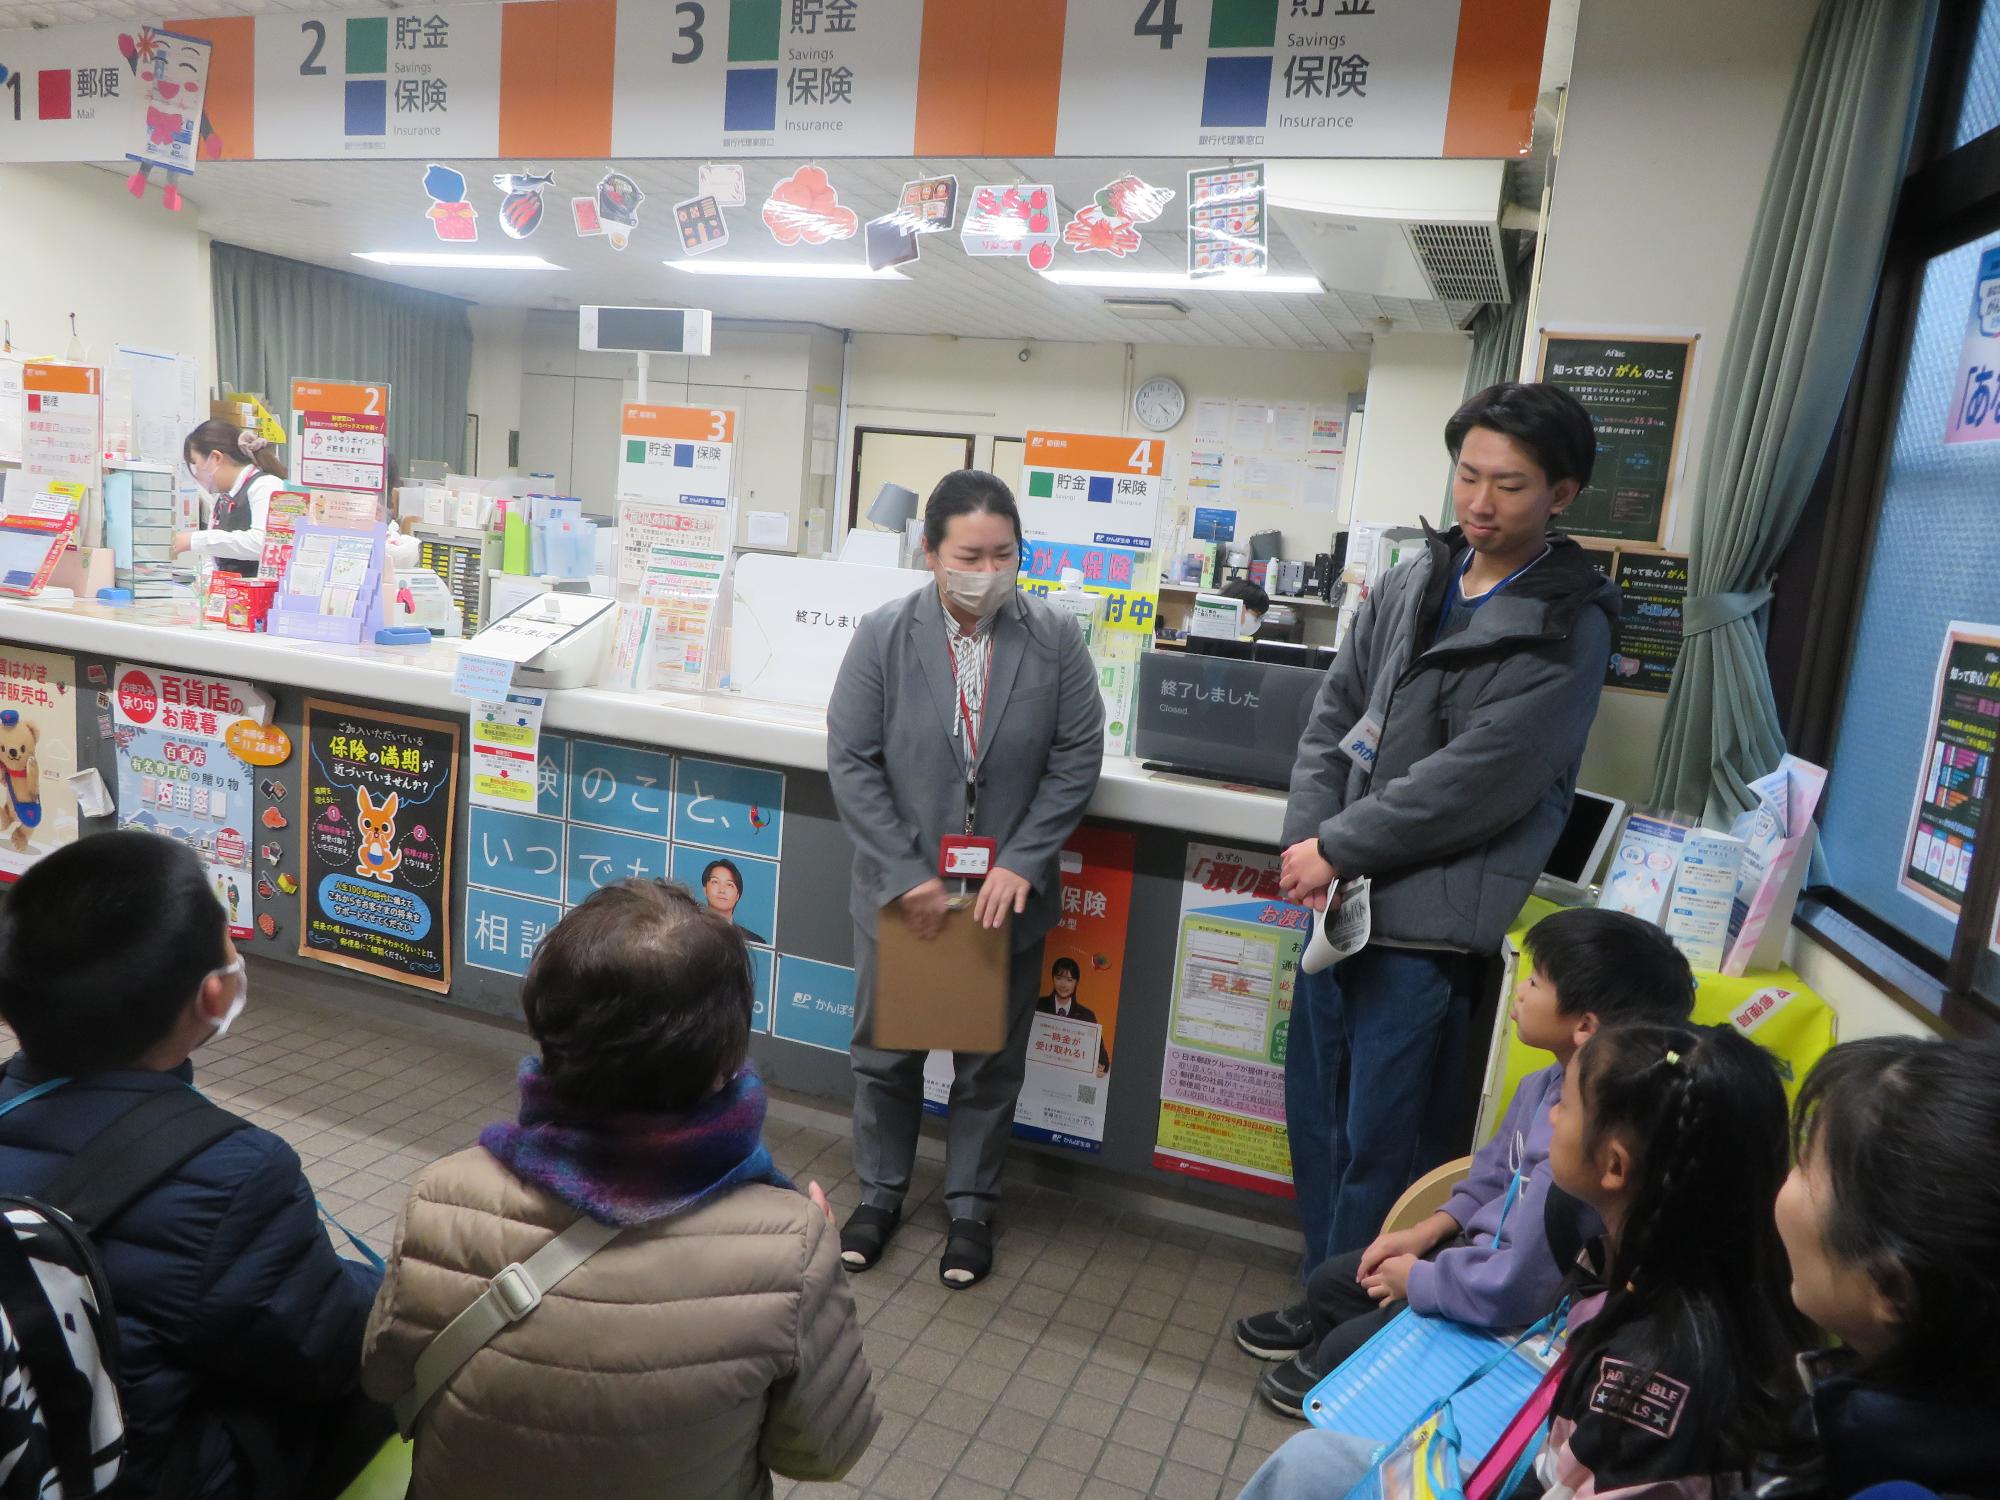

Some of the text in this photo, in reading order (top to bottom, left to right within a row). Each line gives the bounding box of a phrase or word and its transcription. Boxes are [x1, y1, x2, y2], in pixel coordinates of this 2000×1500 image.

[790, 0, 858, 34] 貯金
[1134, 0, 1183, 49] 4
[395, 15, 449, 50] 貯金
[671, 1, 705, 64] 3
[1287, 32, 1346, 48] Savings
[299, 20, 328, 76] 2
[788, 47, 834, 62] Savings
[395, 62, 432, 75] Savings
[1284, 54, 1370, 99] 保険
[6, 72, 21, 120] 1
[77, 68, 119, 98] 郵便
[394, 79, 449, 112] 保険
[786, 67, 853, 105] 保険
[77, 109, 95, 119] Mail
[785, 118, 844, 132] Insurance
[1279, 114, 1354, 129] Insurance
[393, 125, 441, 136] Insurance
[1605, 349, 1625, 358] Aflac
[85, 369, 95, 393] 1
[364, 388, 380, 415] 2
[708, 410, 727, 441] 3
[649, 442, 672, 457] 貯金
[697, 446, 721, 461] 保険
[1128, 440, 1152, 474] 4
[1057, 474, 1086, 491] 貯金
[1117, 479, 1147, 496] 保険
[1031, 549, 1132, 584] がん保険
[493, 624, 560, 639] 終了しました
[120, 682, 155, 697] お申込み
[160, 675, 244, 714] 百貨店の
[1160, 679, 1259, 708] 終了しました
[122, 696, 155, 712] 承り中
[162, 706, 218, 736] お歳暮
[338, 722, 424, 746] ご加入いただいている
[165, 744, 207, 767] 百貨店
[329, 736, 434, 774] 保険の満期が
[132, 757, 239, 791] 有名専門店の贈り物
[334, 763, 429, 793] 近づいていませんか?
[1216, 852, 1243, 863] あずか
[1061, 885, 1107, 918] 保険
[335, 905, 413, 935] サポートさせてください。
[1258, 904, 1310, 929] お渡し
[1736, 993, 1776, 1028] 郵便局
[1035, 1041, 1085, 1059] 受け取れる!
[1042, 1032, 1081, 1046] 一時金が
